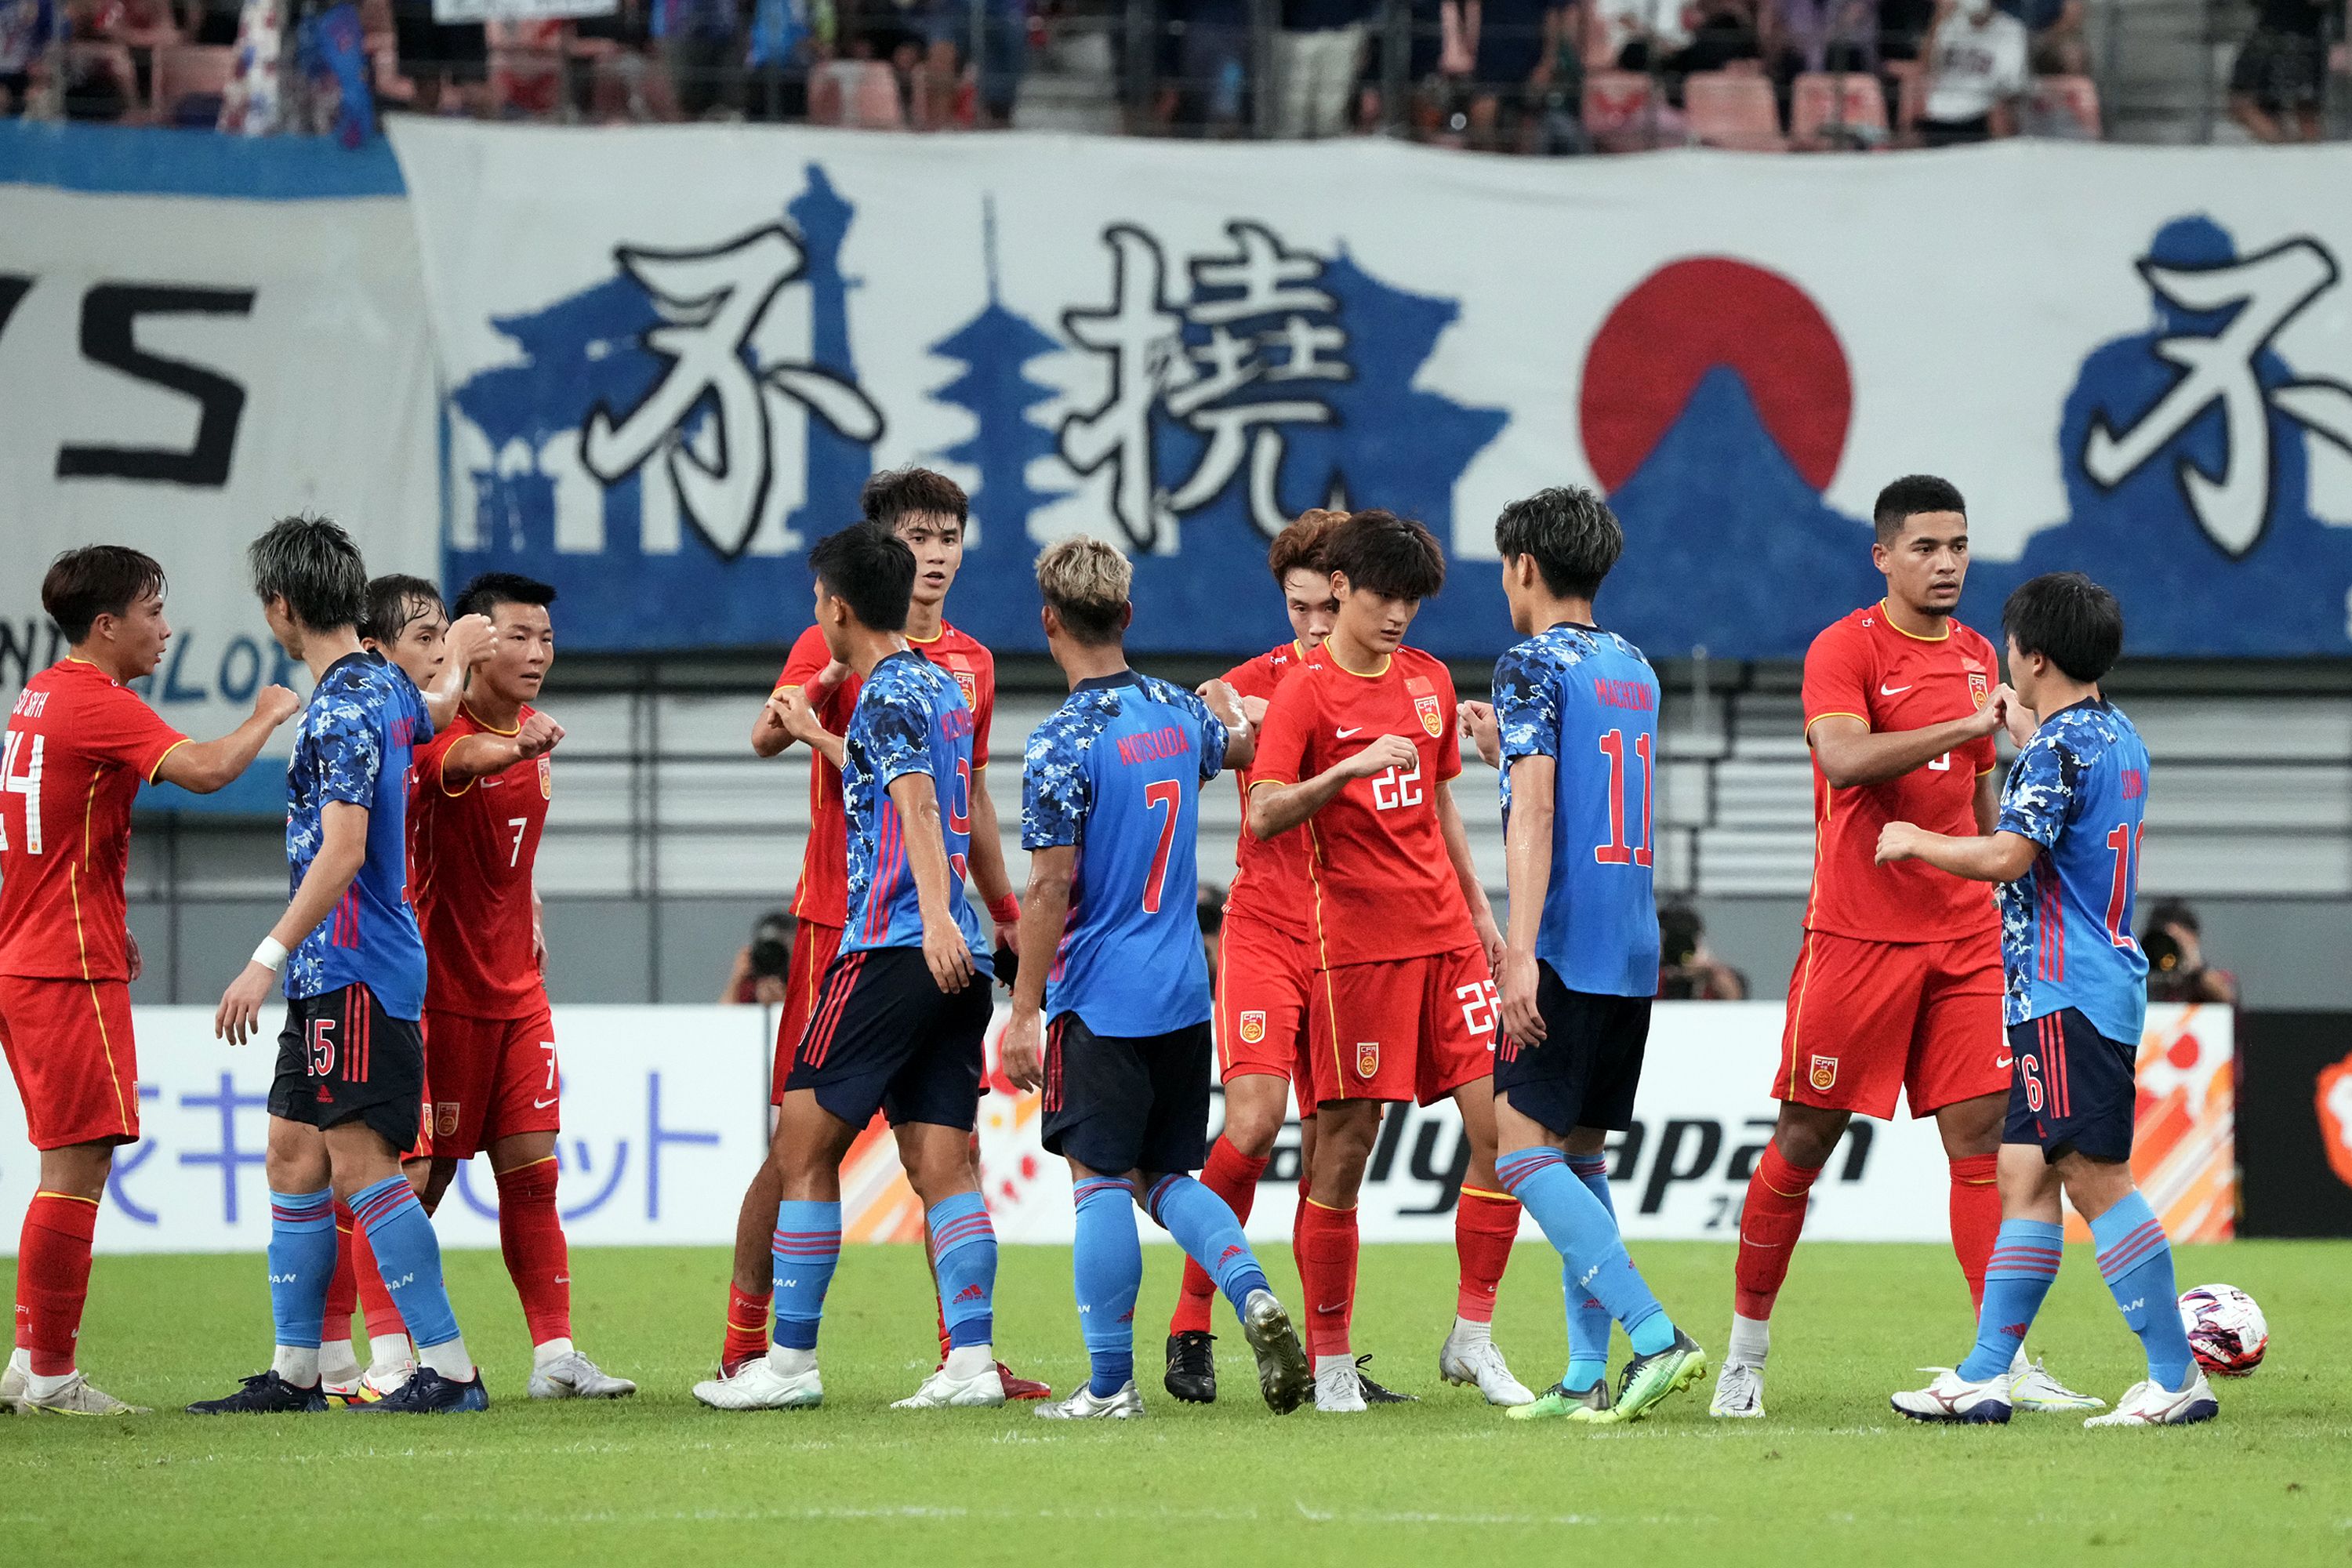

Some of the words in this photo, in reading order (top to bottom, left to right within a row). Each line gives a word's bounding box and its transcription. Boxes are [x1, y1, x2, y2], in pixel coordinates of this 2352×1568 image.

[956, 676, 972, 684] CFA
[1594, 678, 1653, 711] MACHINO
[1971, 677, 1984, 686] CFA
[1417, 699, 1436, 710] CFA
[1116, 724, 1189, 766] NOTSUDA
[1372, 755, 1423, 810] 22
[1595, 728, 1653, 869] 11
[508, 817, 527, 867] 7
[1142, 779, 1181, 914] 7
[539, 1041, 555, 1090] 7
